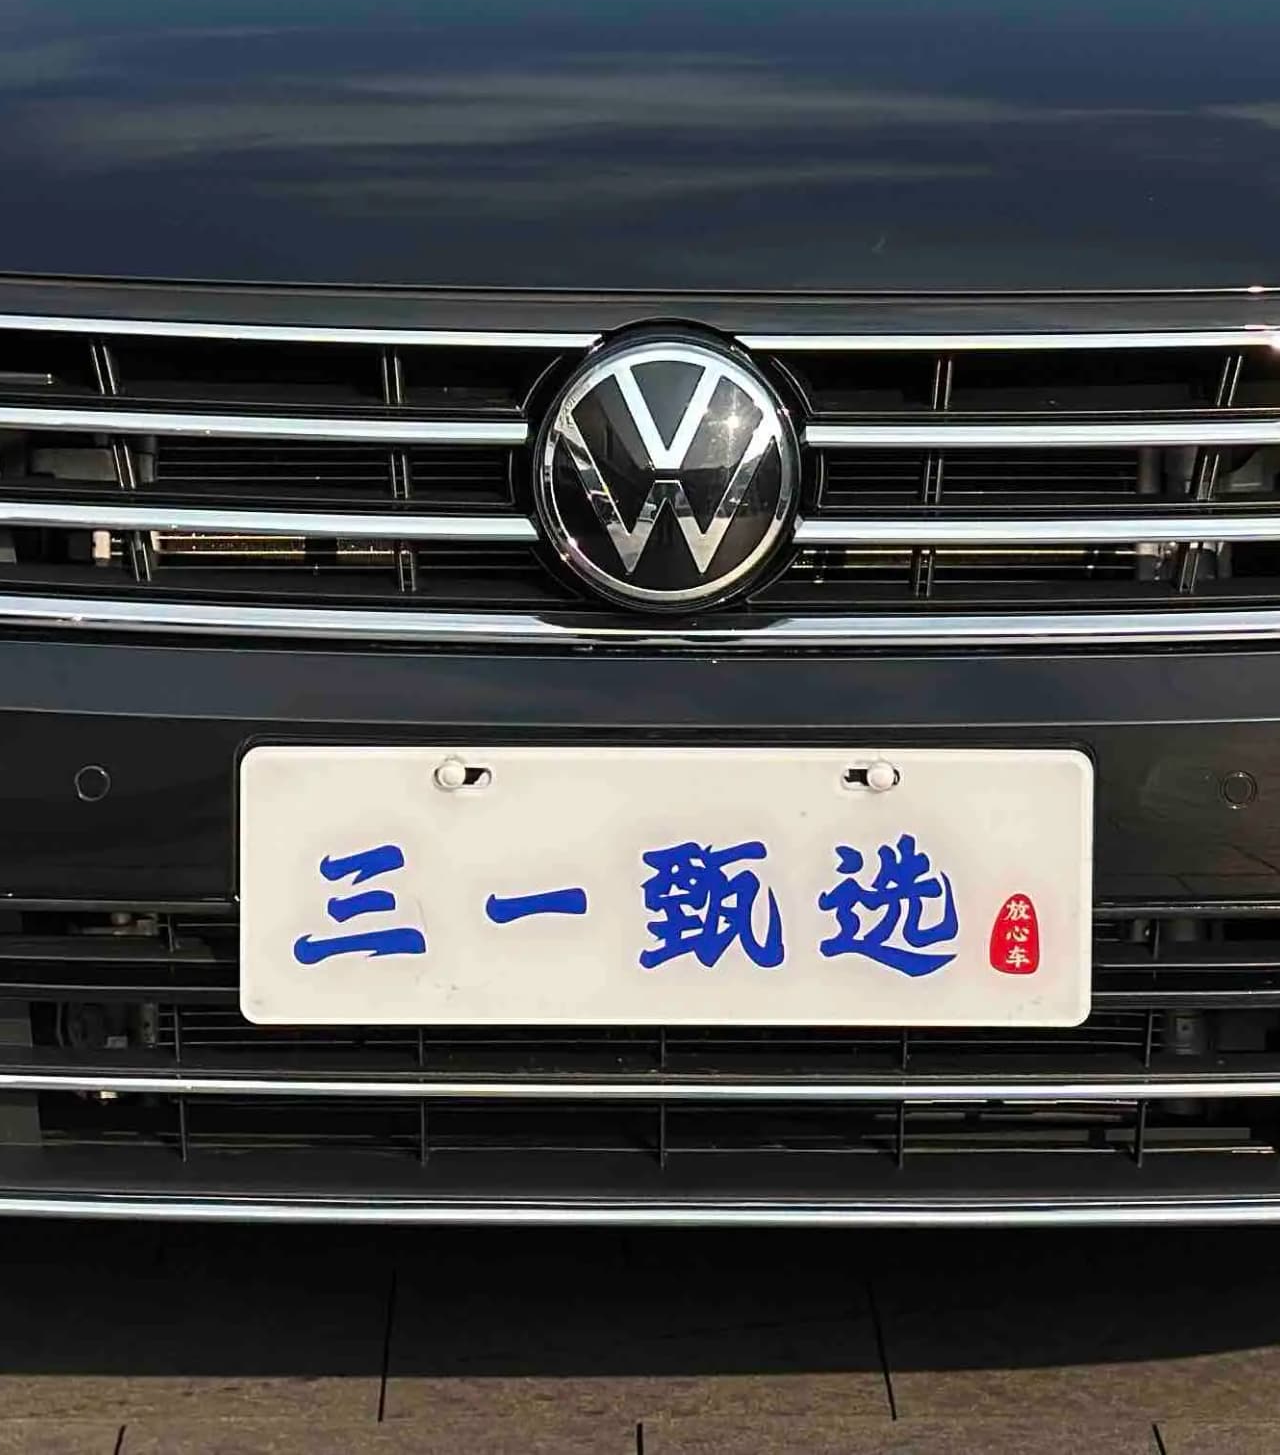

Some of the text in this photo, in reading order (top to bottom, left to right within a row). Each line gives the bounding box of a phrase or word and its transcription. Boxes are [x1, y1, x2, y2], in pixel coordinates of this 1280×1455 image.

[293, 835, 957, 976] 三一甄选
[1002, 899, 1031, 968] 放心车
